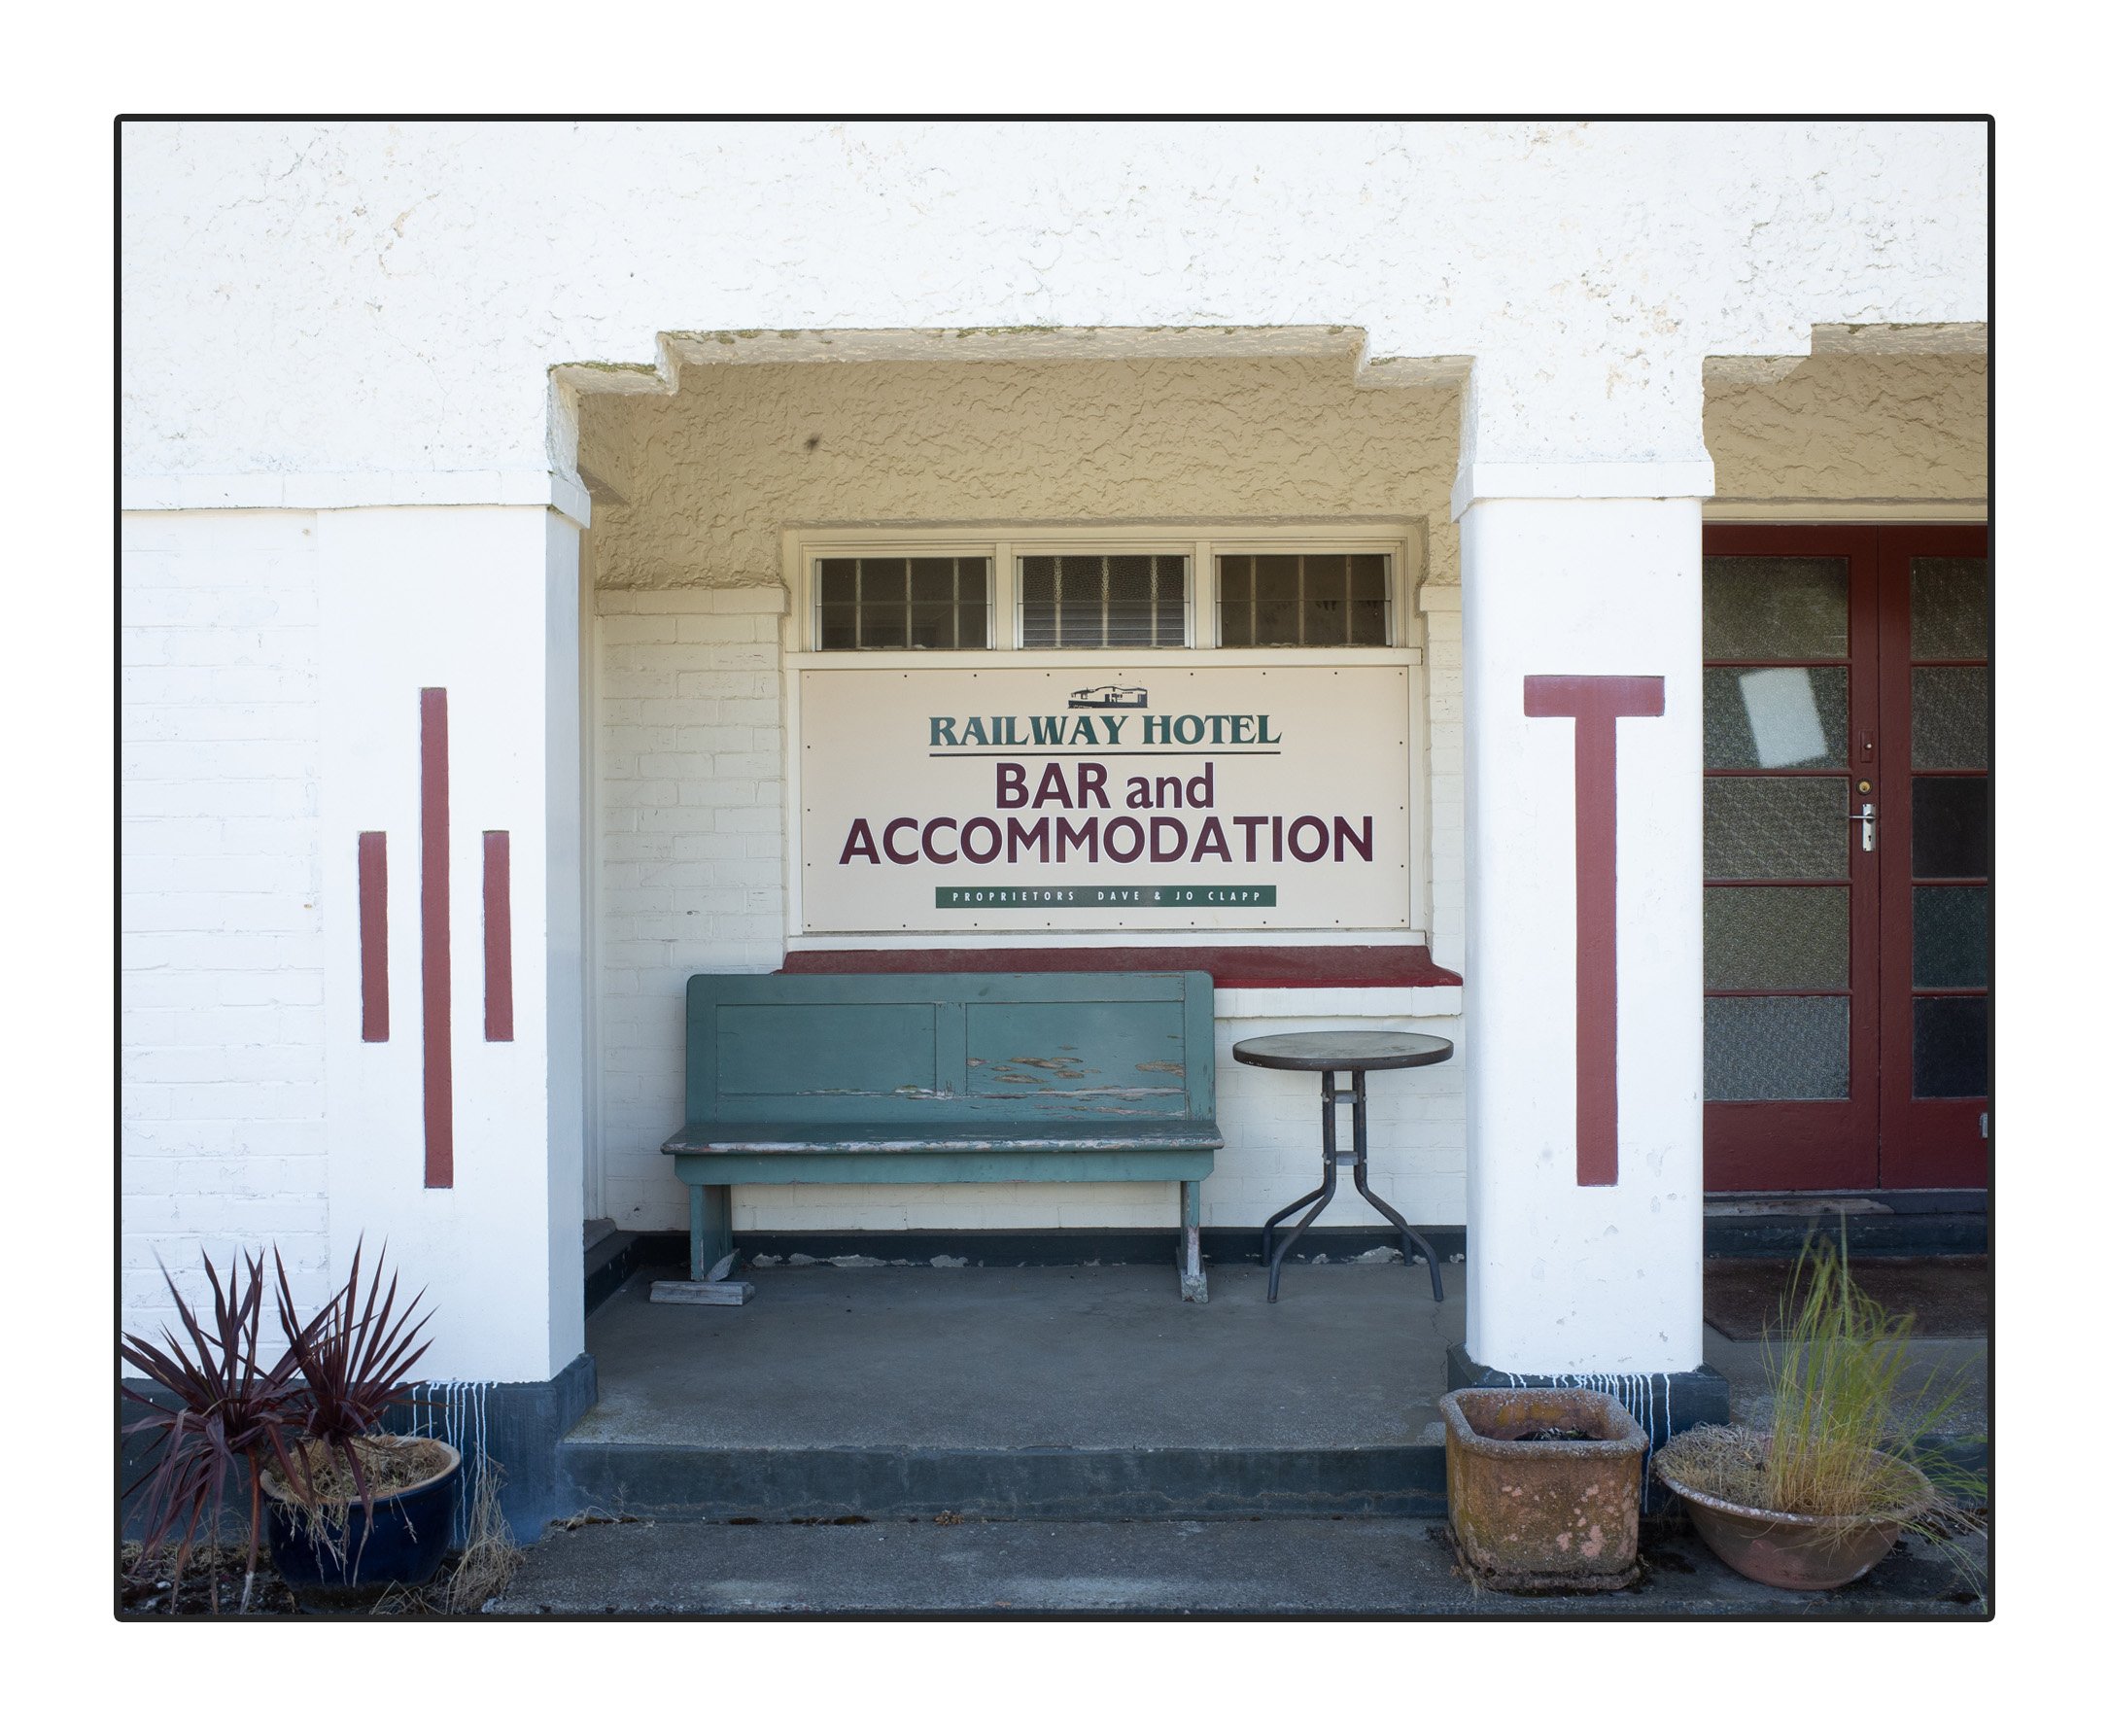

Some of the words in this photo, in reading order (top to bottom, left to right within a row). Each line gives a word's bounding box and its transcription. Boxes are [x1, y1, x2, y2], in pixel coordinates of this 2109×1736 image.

[928, 715, 1129, 746] RAILWAY
[1142, 714, 1283, 746] HOTEL
[996, 762, 1112, 810] BAR
[1125, 761, 1214, 810] and
[838, 815, 1373, 865] ACCOMMODATION
[952, 891, 1074, 902] PROPRIETORS
[1097, 891, 1140, 901] DAVE
[1154, 891, 1161, 901] &
[1175, 890, 1194, 901] JO
[1208, 890, 1261, 901] CLAPP
